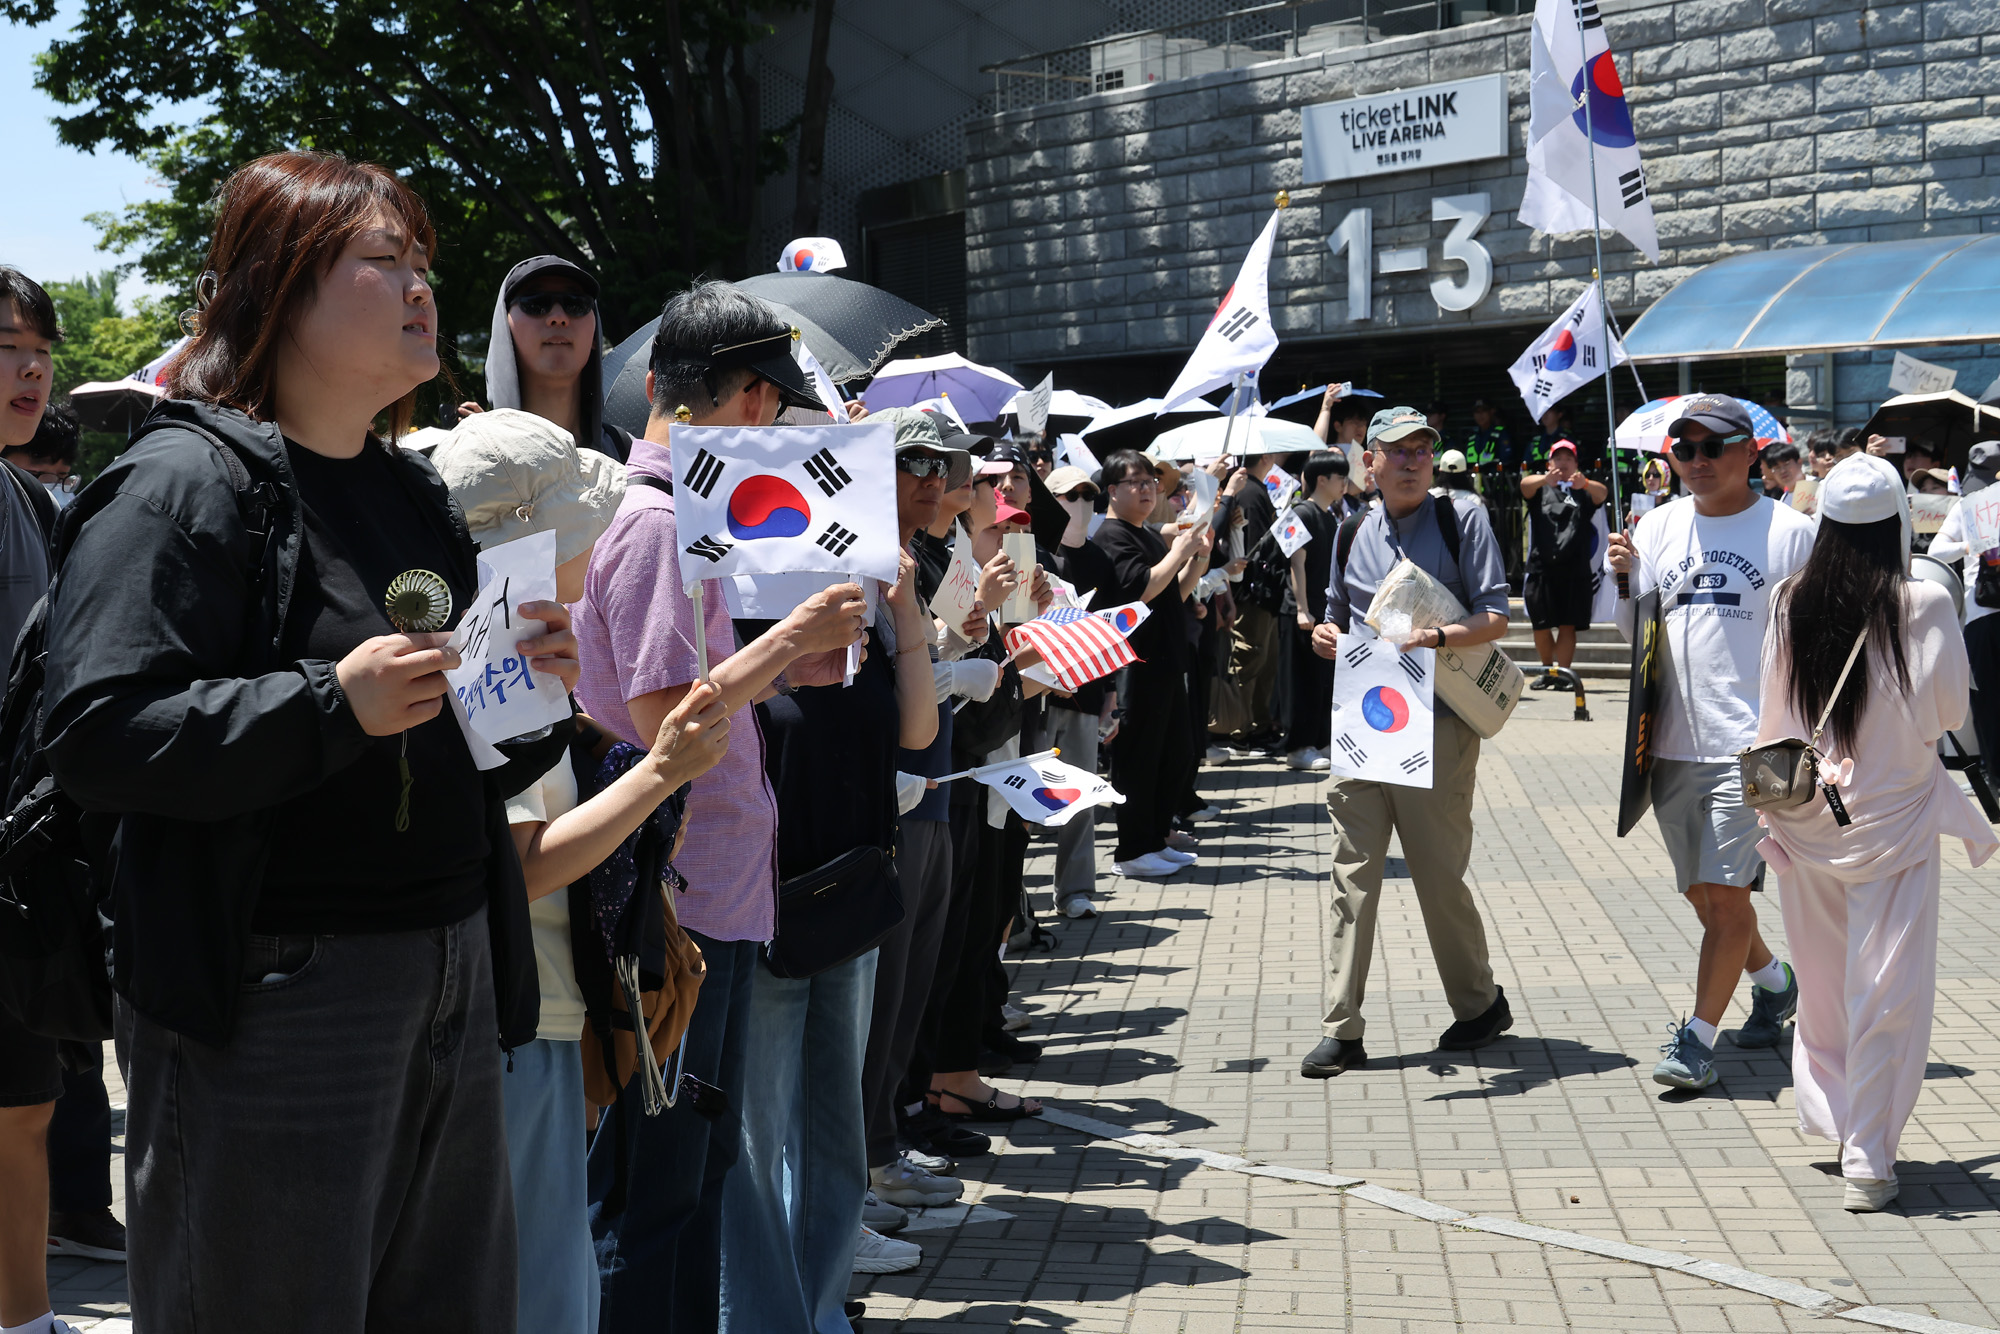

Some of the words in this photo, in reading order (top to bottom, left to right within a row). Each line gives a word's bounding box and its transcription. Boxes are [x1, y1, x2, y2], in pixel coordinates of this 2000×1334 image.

[1341, 91, 1458, 133] ticketLINK
[1352, 129, 1387, 150] LIVE
[1390, 121, 1446, 144] ARENA
[1327, 192, 1493, 321] 1-3
[1662, 570, 1678, 591] WE
[1678, 556, 1695, 573] GO
[1702, 550, 1766, 591] TOGETHER
[1698, 575, 1722, 588] 1953
[1691, 607, 1703, 617] US
[1704, 607, 1754, 621] ALLIANCE
[1826, 786, 1842, 814] SONY
